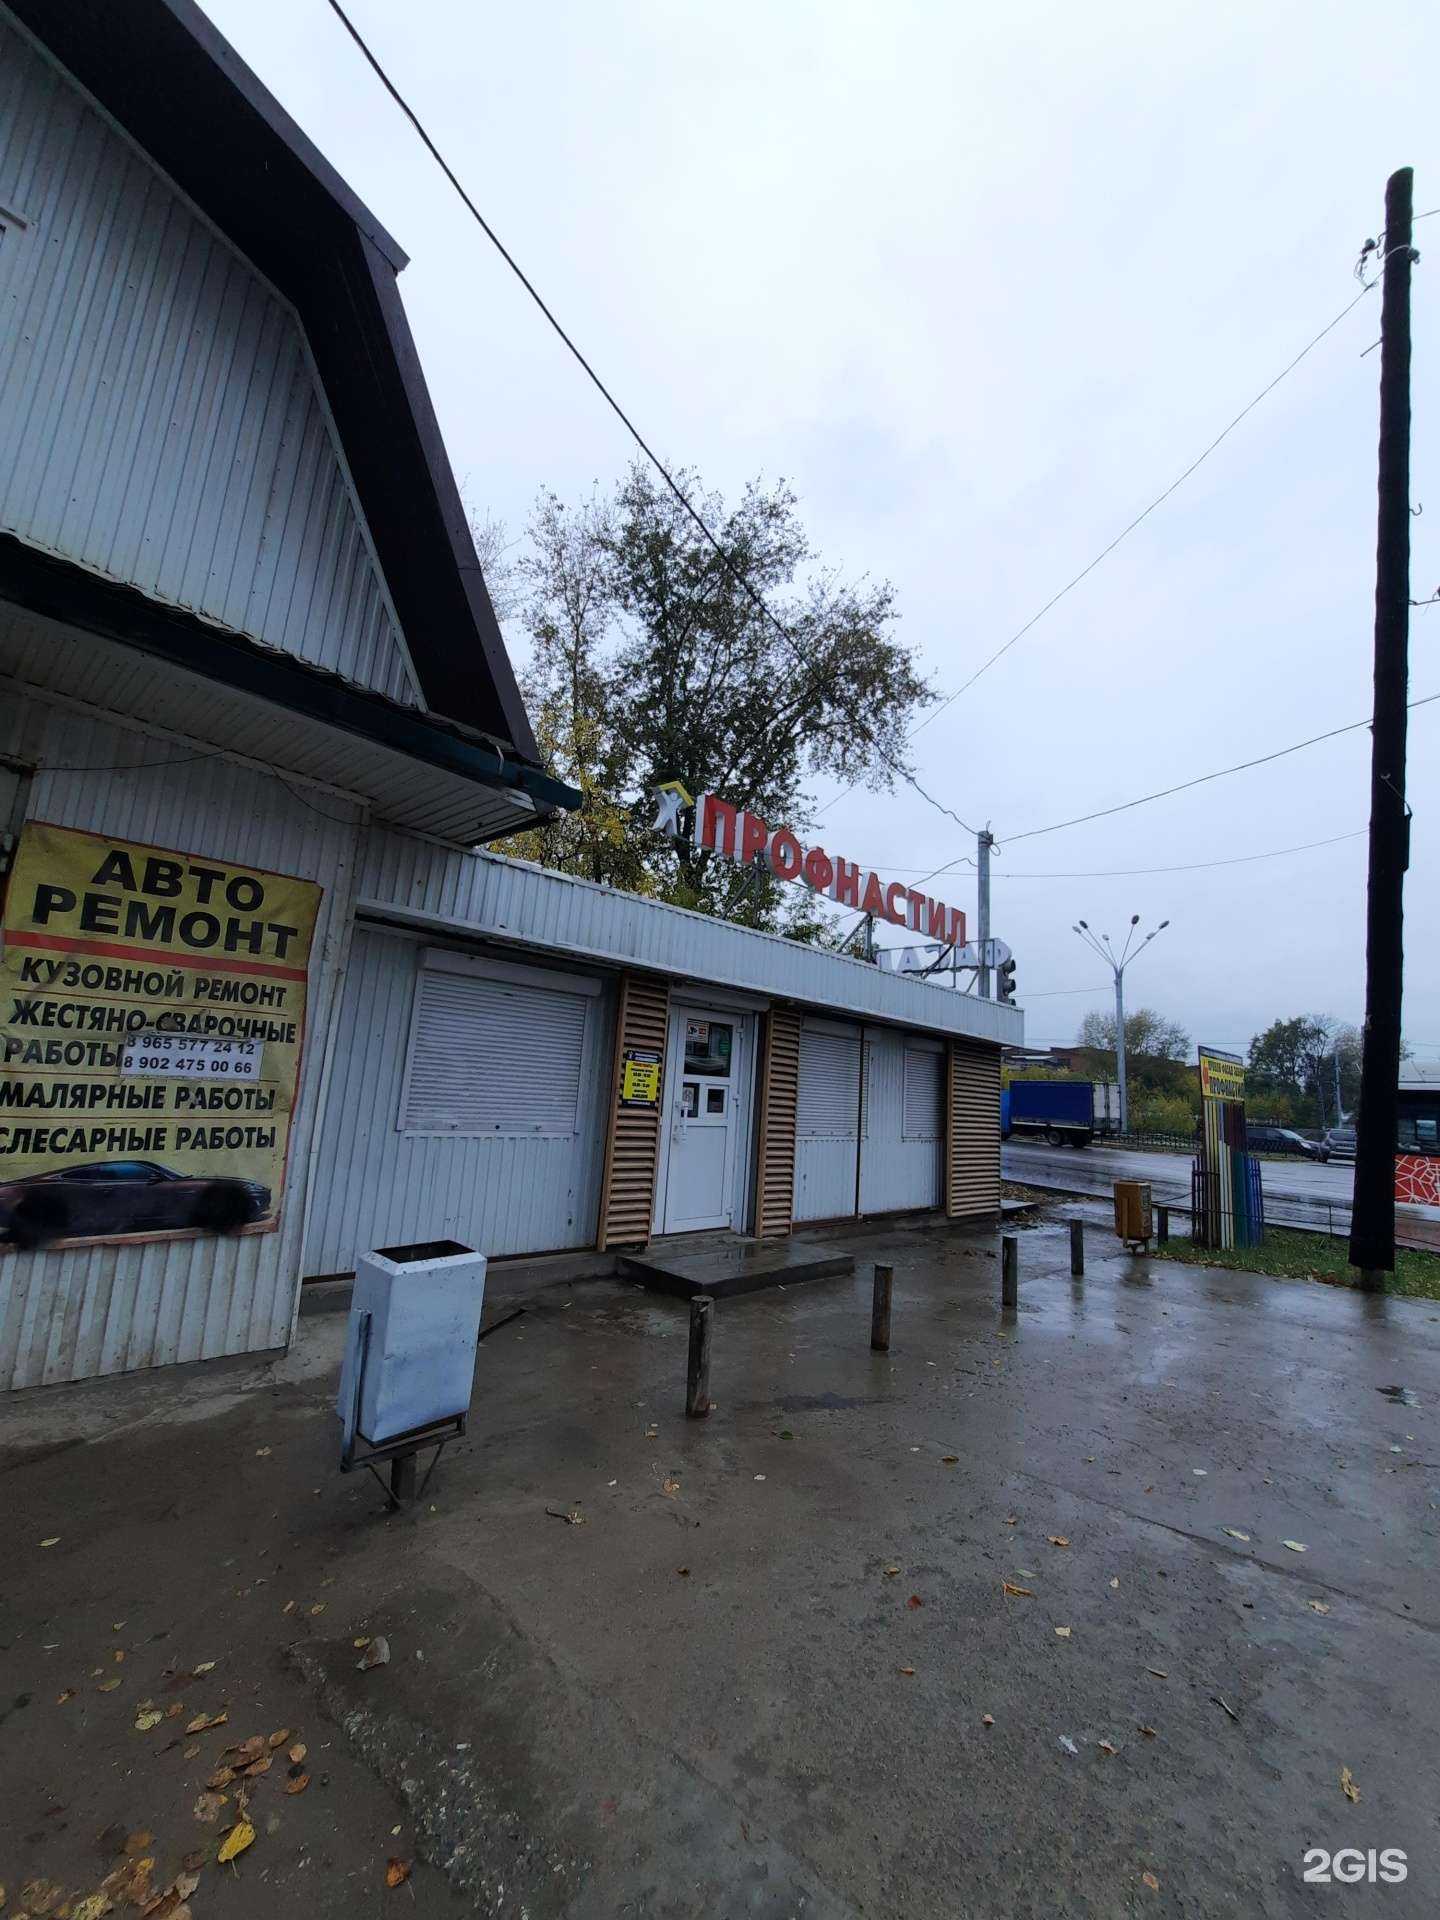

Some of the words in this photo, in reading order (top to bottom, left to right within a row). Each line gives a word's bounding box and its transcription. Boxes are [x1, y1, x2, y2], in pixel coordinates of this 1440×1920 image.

[91, 849, 265, 912] АВТО
[695, 793, 967, 948] ПРОФНАСТИЛ
[31, 883, 298, 959] РЕМОНТ
[20, 957, 184, 998] КУЗОВНОЙ
[193, 977, 287, 1008] РЕМОНТ
[8, 999, 297, 1044] ЖЕСТЯНО-СВАРОЧНЫЕ
[4, 1038, 124, 1067] РАБОТЫ
[142, 1036, 172, 1050] 965
[178, 1038, 208, 1052] 577
[213, 1041, 232, 1054] 24
[238, 1042, 255, 1055] 12
[123, 1056, 133, 1068] 8
[139, 1057, 170, 1069] 902
[175, 1059, 205, 1071] 475
[210, 1061, 229, 1072] 00
[234, 1062, 252, 1073] 66
[0, 1081, 166, 1109] МАЛЯРНЫЕ
[174, 1086, 275, 1110] РАБОТЫ
[0, 1127, 167, 1154] СЛЕСАРНЫЕ
[175, 1126, 276, 1150] РАБОТЫ
